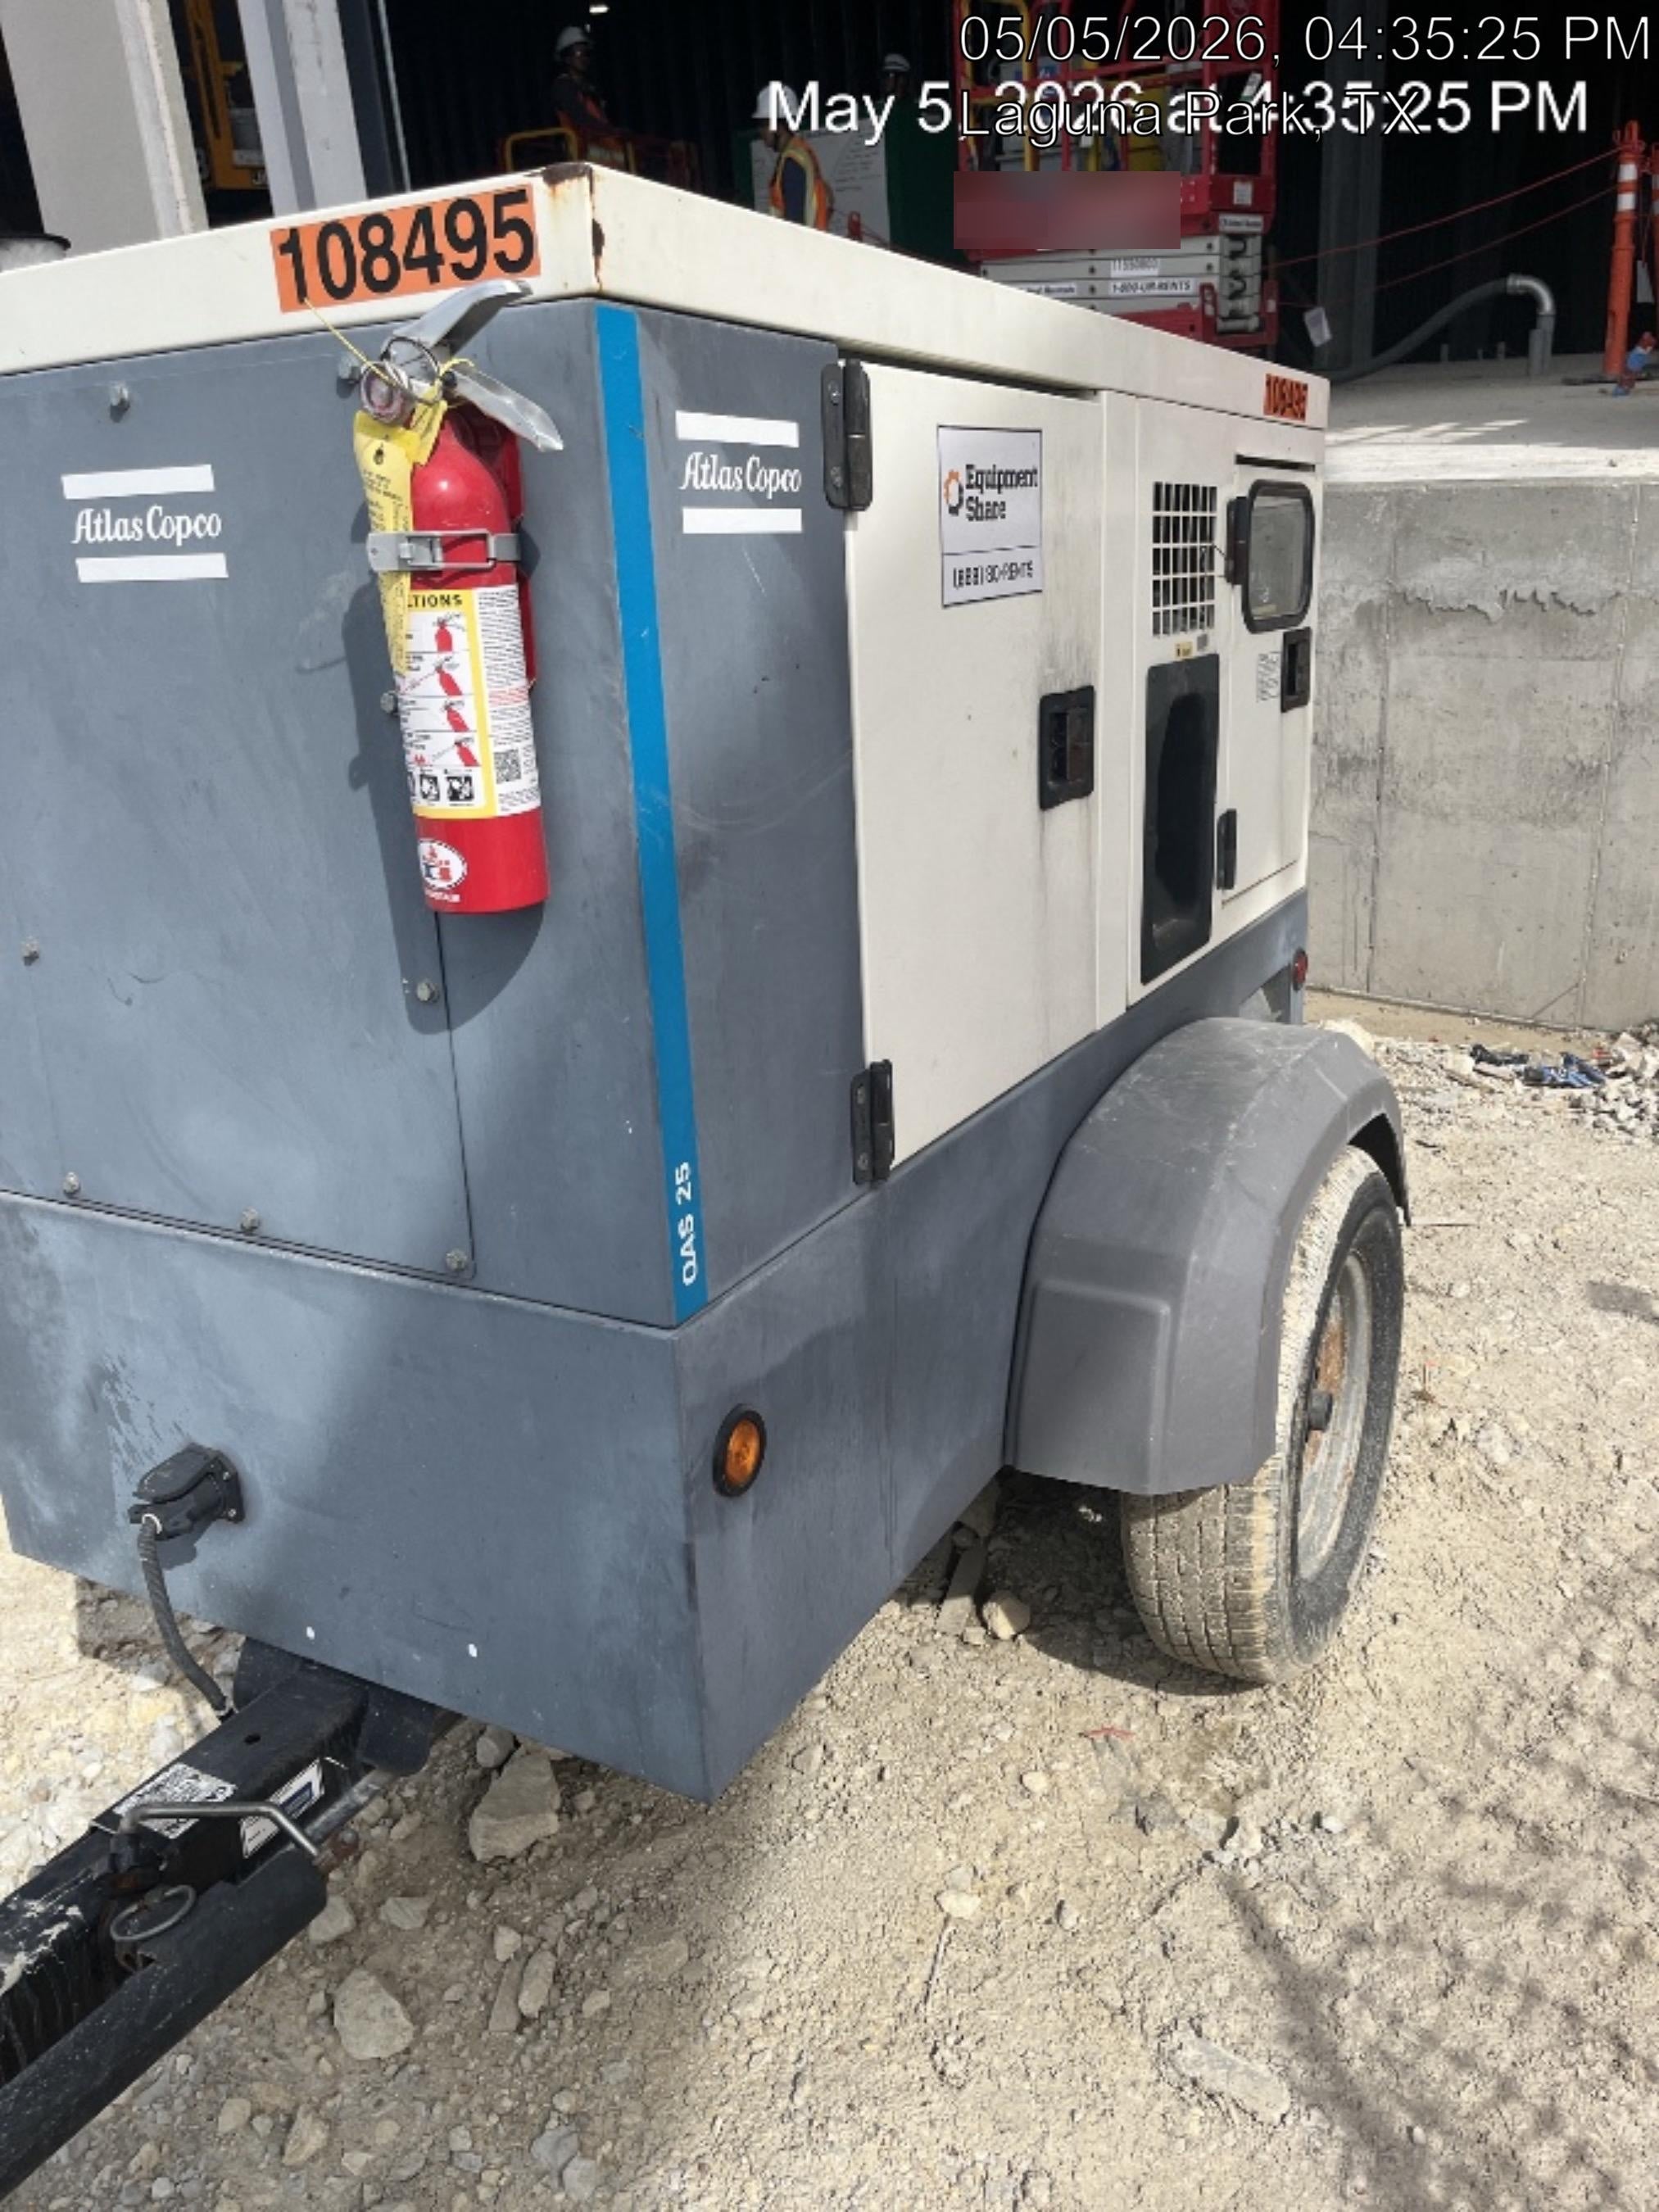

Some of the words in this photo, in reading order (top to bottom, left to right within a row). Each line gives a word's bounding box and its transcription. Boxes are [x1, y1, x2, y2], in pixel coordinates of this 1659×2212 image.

[279, 188, 534, 305] 108495
[678, 451, 743, 492] Atlas
[746, 454, 802, 500] Copco
[964, 463, 1038, 495] Equipment
[70, 507, 143, 544] Atlas
[146, 504, 223, 547] Copco
[965, 495, 1007, 522] Share
[408, 593, 464, 609] TIONS
[674, 1161, 692, 1206] 25
[677, 1213, 699, 1287] QAS
